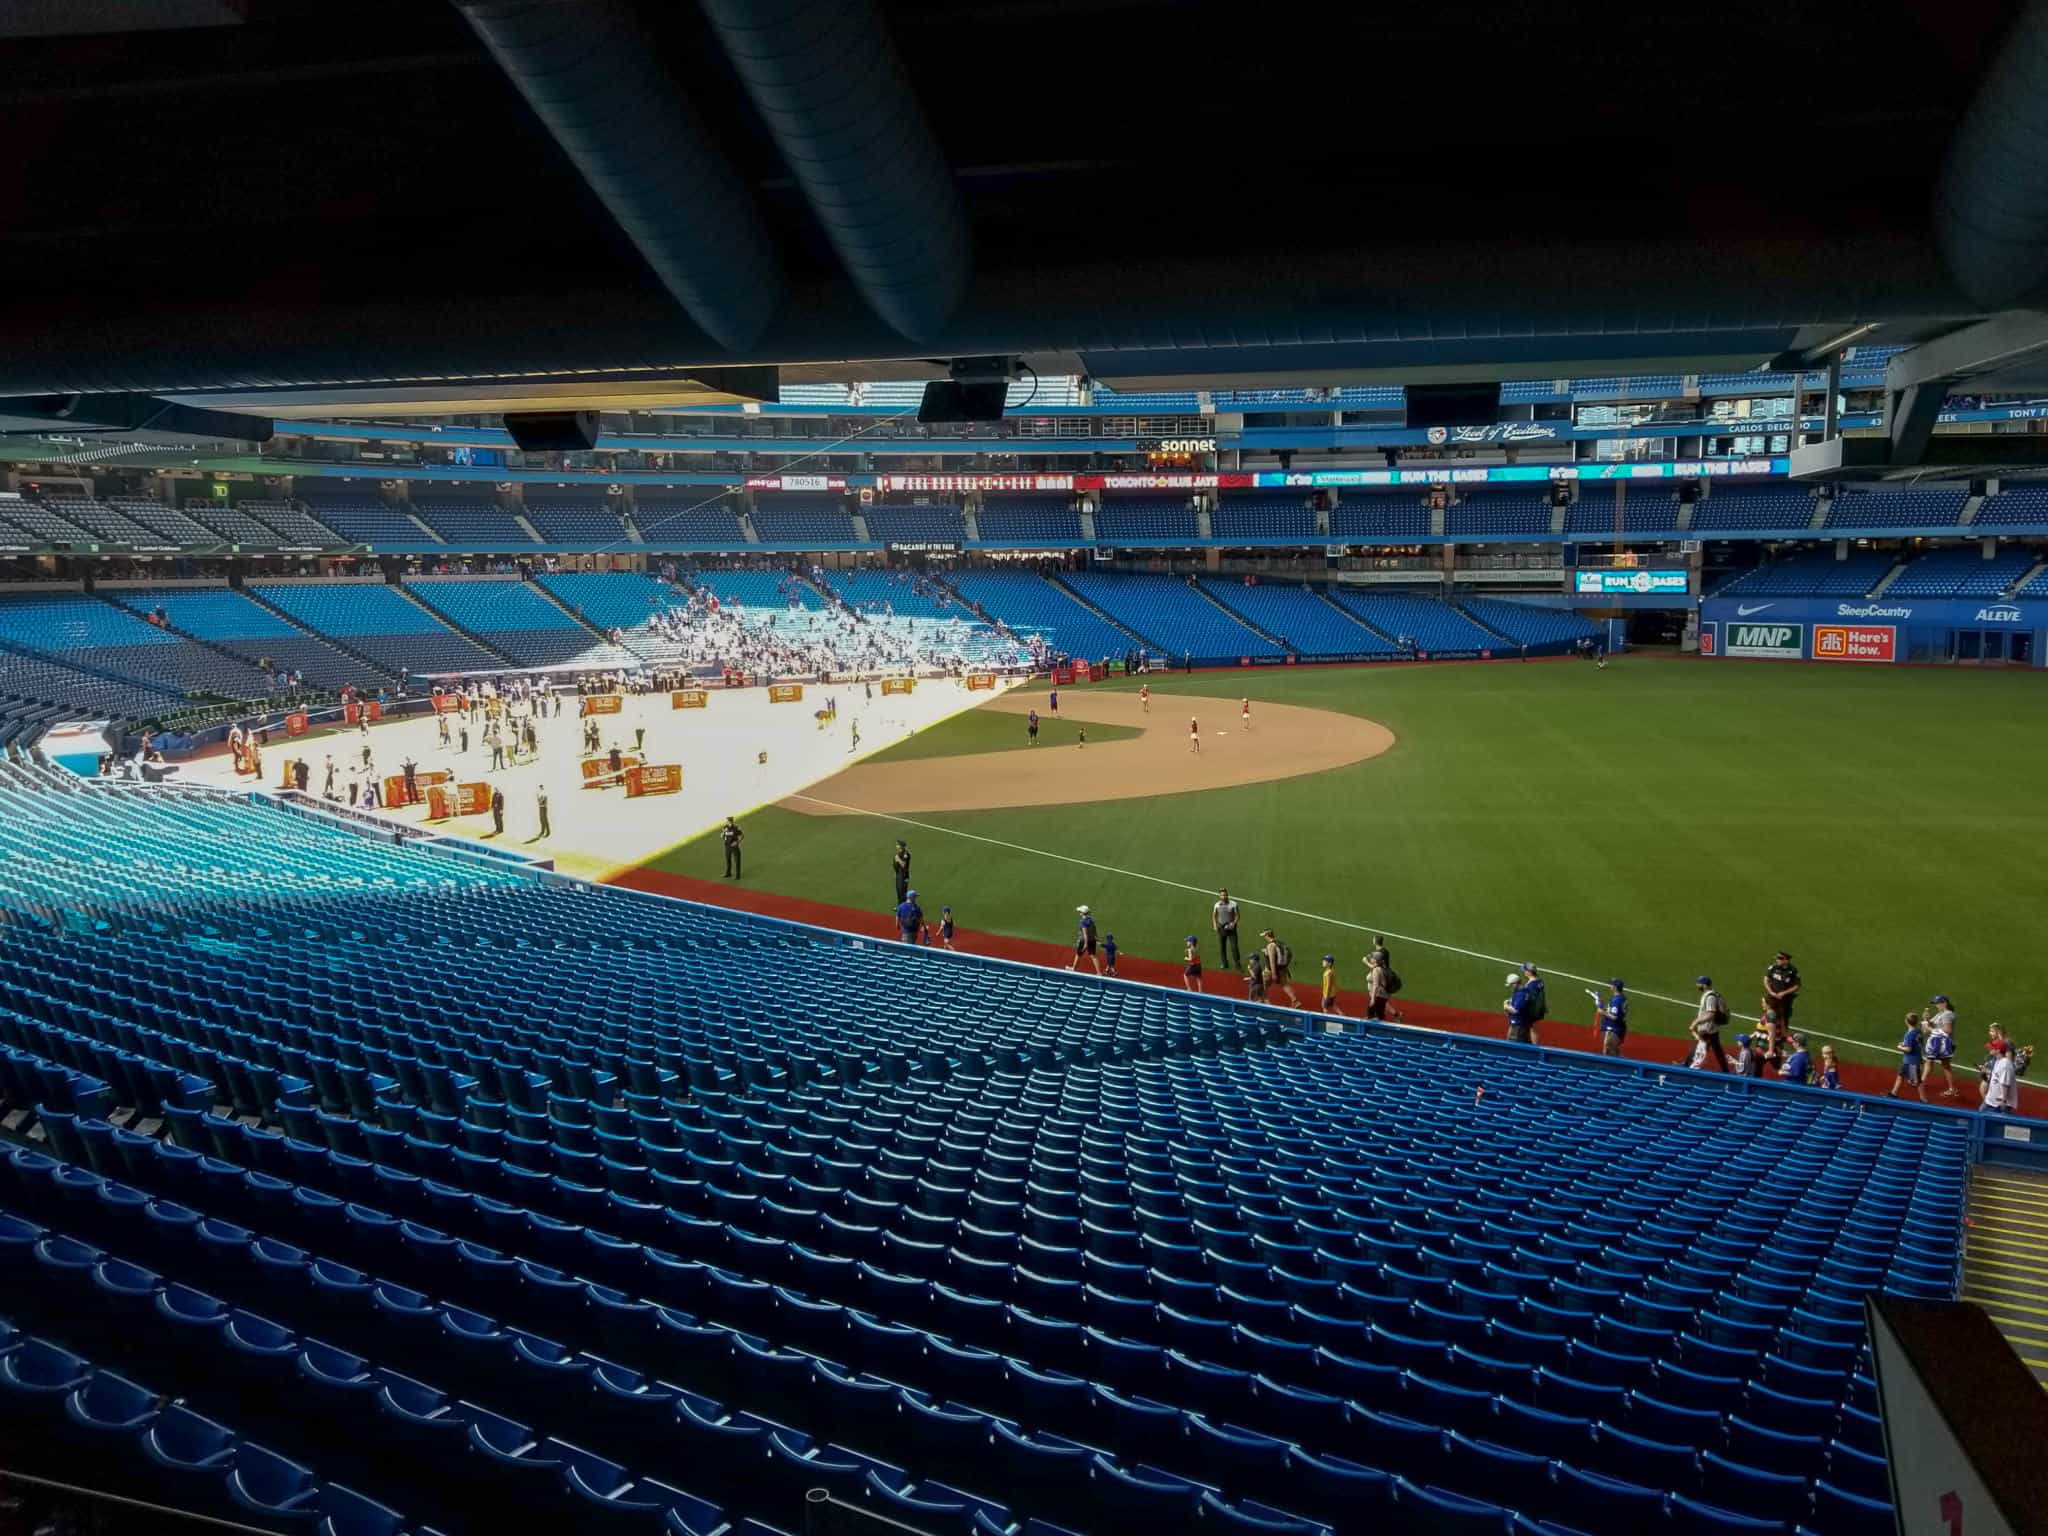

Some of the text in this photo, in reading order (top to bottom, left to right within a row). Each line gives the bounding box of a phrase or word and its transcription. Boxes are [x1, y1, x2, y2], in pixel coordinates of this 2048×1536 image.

[2008, 408, 2036, 418] TONY
[1452, 423, 1556, 441] Level of Excellence
[1729, 422, 1810, 433] CARLOS DELGO
[1161, 439, 1216, 451] sonnet
[1674, 460, 1771, 475] RUN THE BASES
[1105, 476, 1218, 488] TORONTO BLUE JAYS
[1401, 470, 1425, 483] RUN
[1426, 470, 1450, 482] THE
[1452, 469, 1488, 482] BASES
[214, 485, 228, 497] TD
[1604, 576, 1630, 586] RUN
[1652, 576, 1686, 586] BASES
[1837, 604, 1912, 619] SleepCountry
[1975, 608, 2022, 622] ALEVE
[1736, 627, 1792, 647] MNP
[1849, 632, 1889, 643] Here's
[1849, 644, 1880, 655] How.
